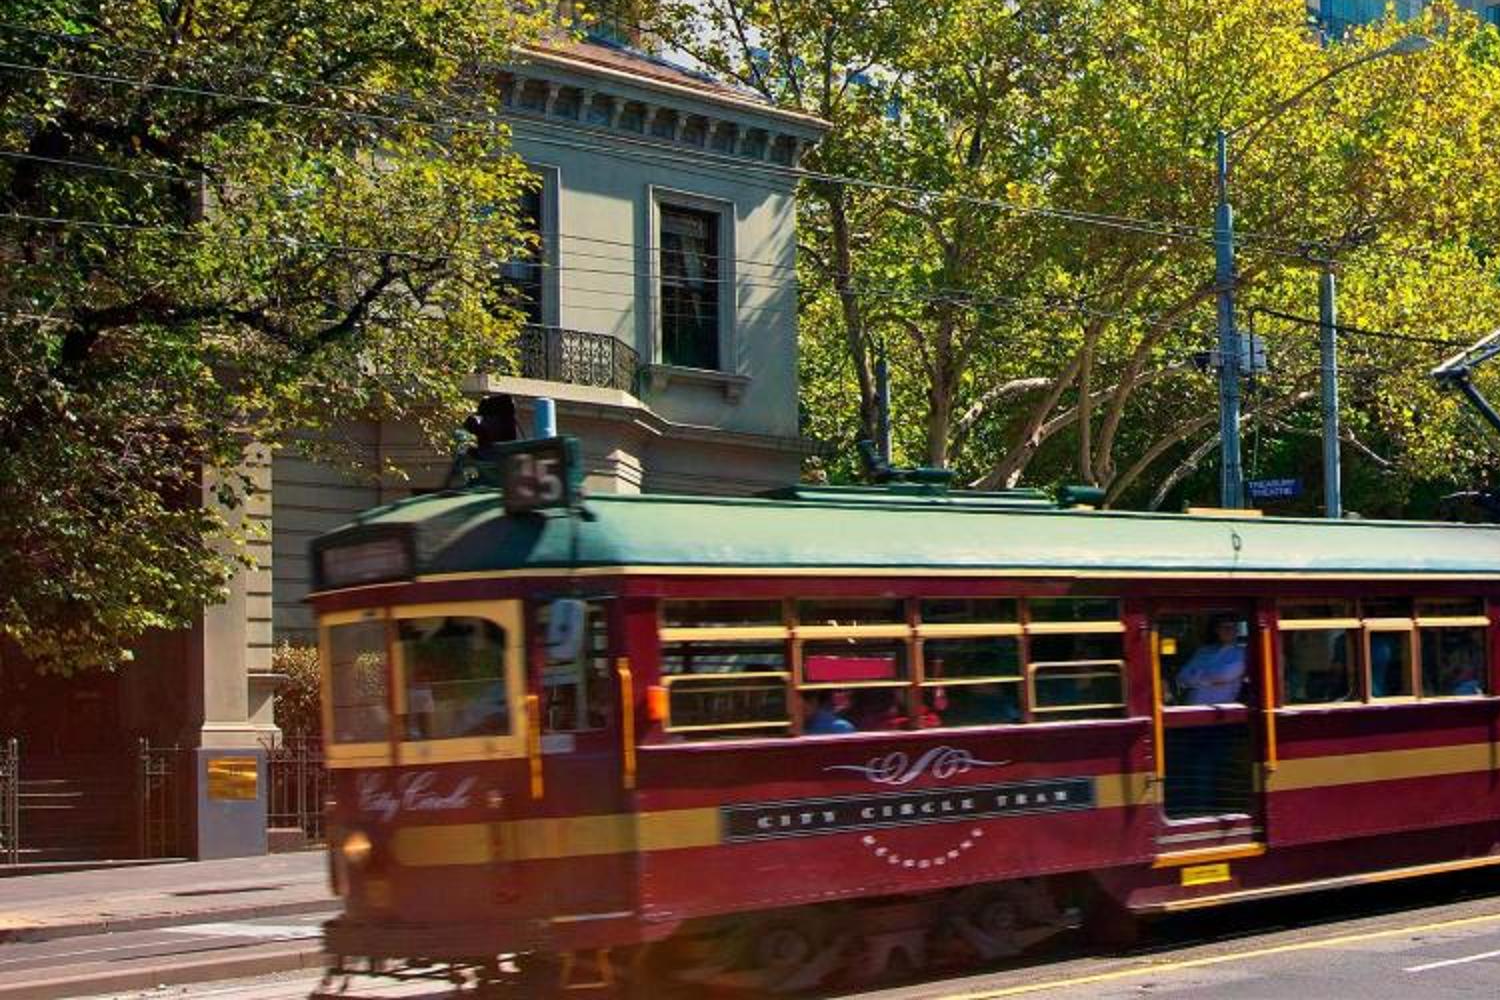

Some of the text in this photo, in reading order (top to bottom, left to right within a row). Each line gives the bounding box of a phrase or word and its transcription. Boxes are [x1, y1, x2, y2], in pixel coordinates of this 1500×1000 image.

[757, 791, 1068, 829] CITY CIRCLE TRAM
